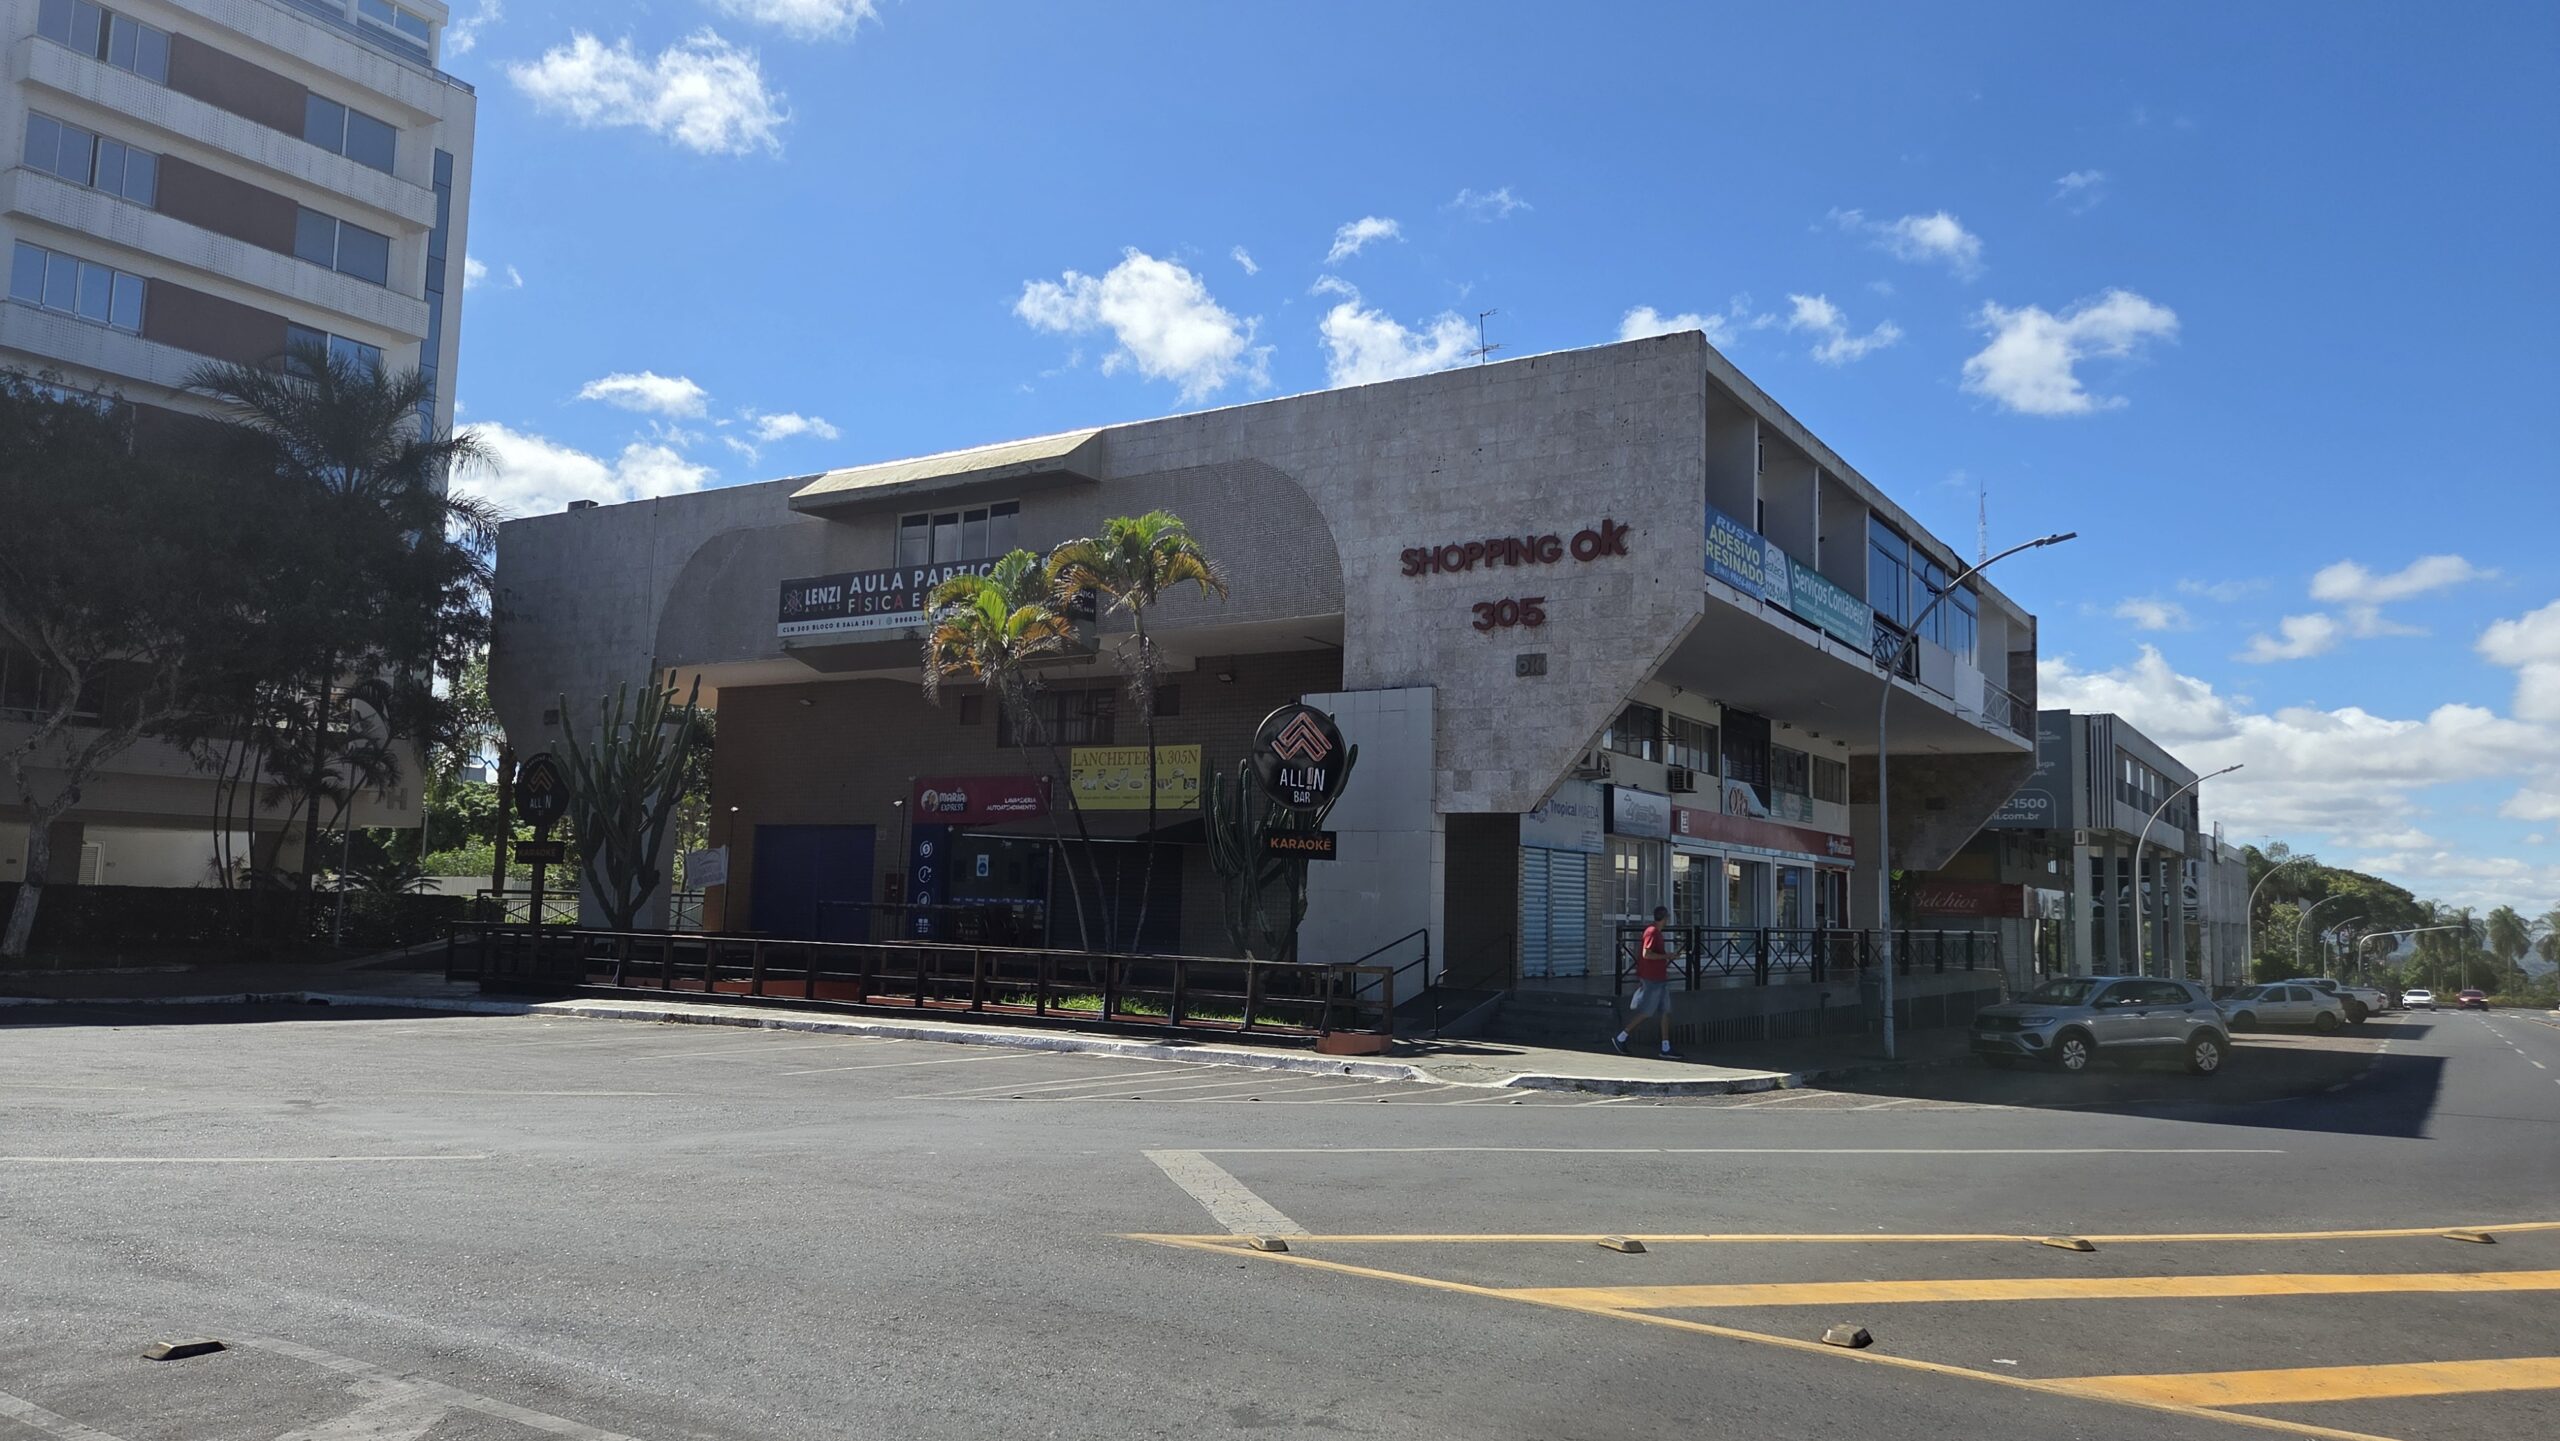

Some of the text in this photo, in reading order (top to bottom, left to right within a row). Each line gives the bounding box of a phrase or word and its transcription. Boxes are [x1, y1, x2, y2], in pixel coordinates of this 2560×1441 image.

[1716, 515, 1756, 542] RUST
[1400, 533, 1563, 576] SHOPPING
[1709, 525, 1761, 566] ADESIVO
[1705, 540, 1765, 586] RESINADO
[849, 572, 904, 595] AULA
[805, 586, 841, 606] LENZI
[912, 592, 921, 609] E
[1793, 565, 1829, 606] Serviços
[1828, 585, 1864, 625] Contábeis
[1471, 596, 1546, 631] 305
[812, 622, 834, 631] BLOCO
[842, 620, 860, 628] SALA
[1073, 749, 1198, 767] LANCHETERA 305N
[939, 792, 967, 803] MARIA
[940, 802, 965, 812] EXPRESS
[1293, 790, 1311, 804] BAR
[1550, 799, 1577, 818] Tropical
